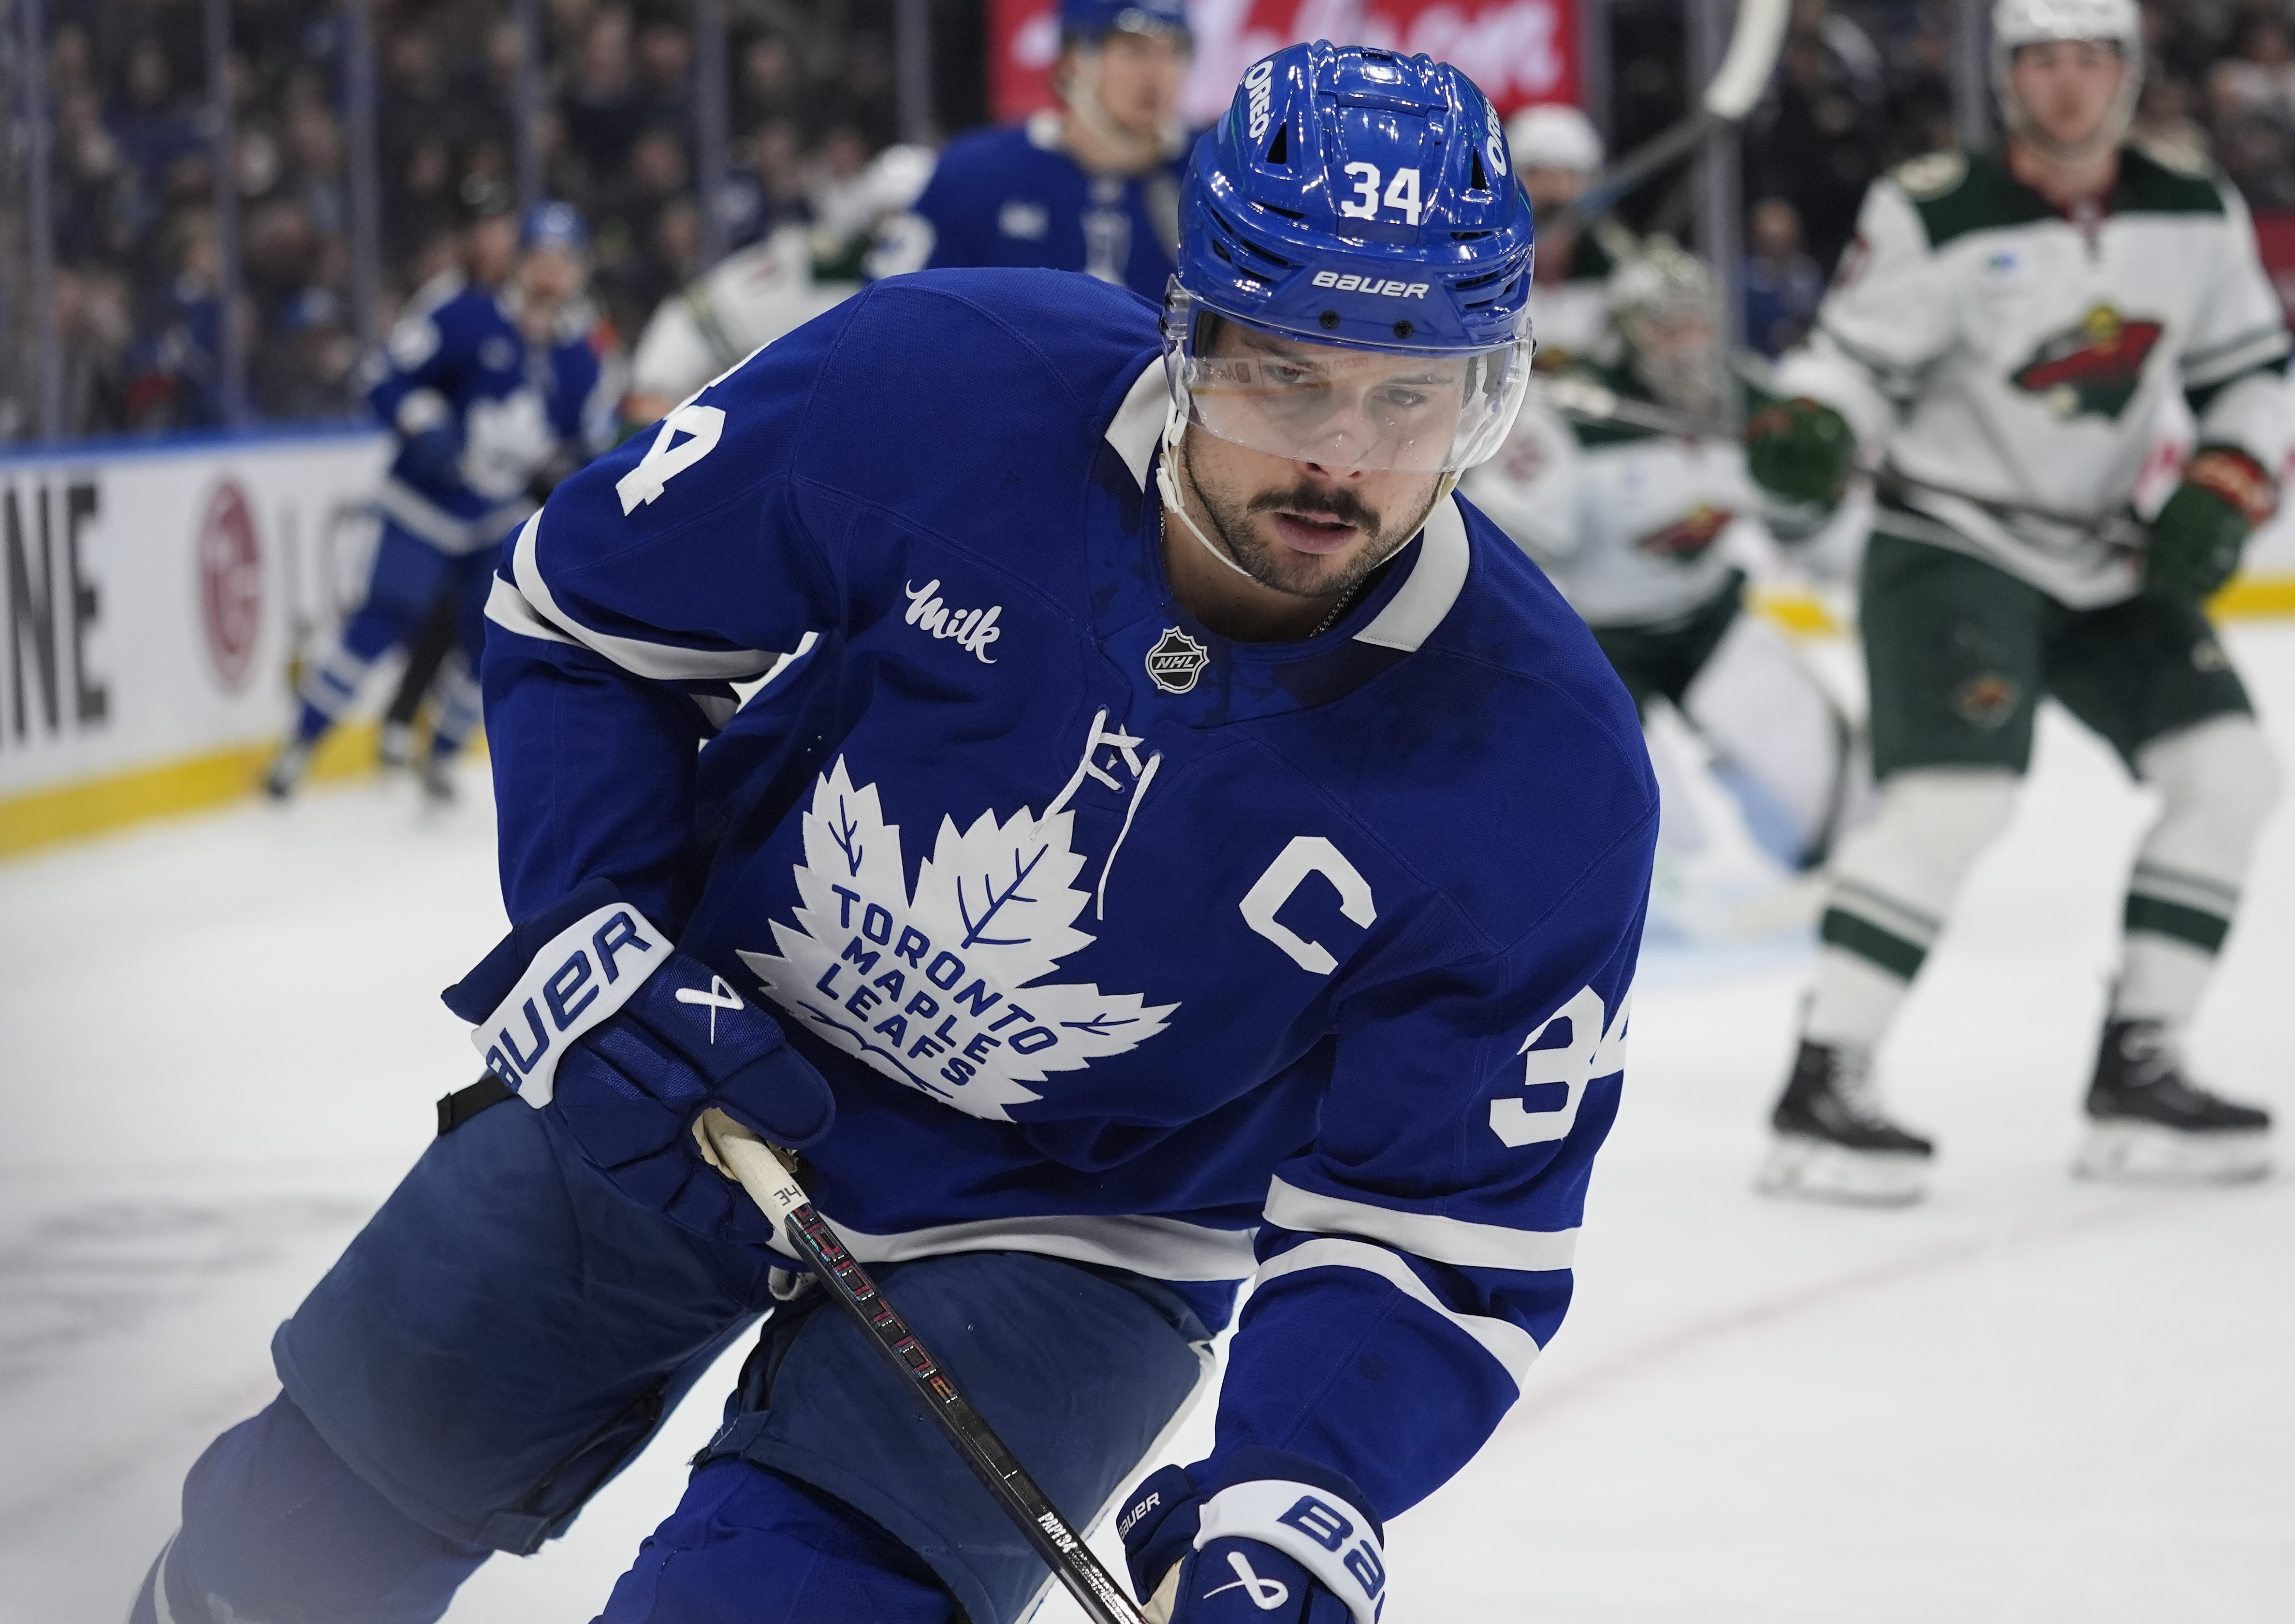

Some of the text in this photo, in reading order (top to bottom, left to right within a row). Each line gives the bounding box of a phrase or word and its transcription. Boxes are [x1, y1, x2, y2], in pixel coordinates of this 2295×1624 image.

[1244, 60, 1273, 139] OREO
[1340, 161, 1422, 226] 34
[1155, 655, 1194, 669] NHL
[1239, 835, 1377, 975] C
[816, 966, 977, 1086] LEAFS
[831, 884, 1058, 1056] TORONTO
[840, 936, 1001, 1065] MAPLE
[774, 1184, 803, 1206] 34
[1276, 1495, 1386, 1624] BA
